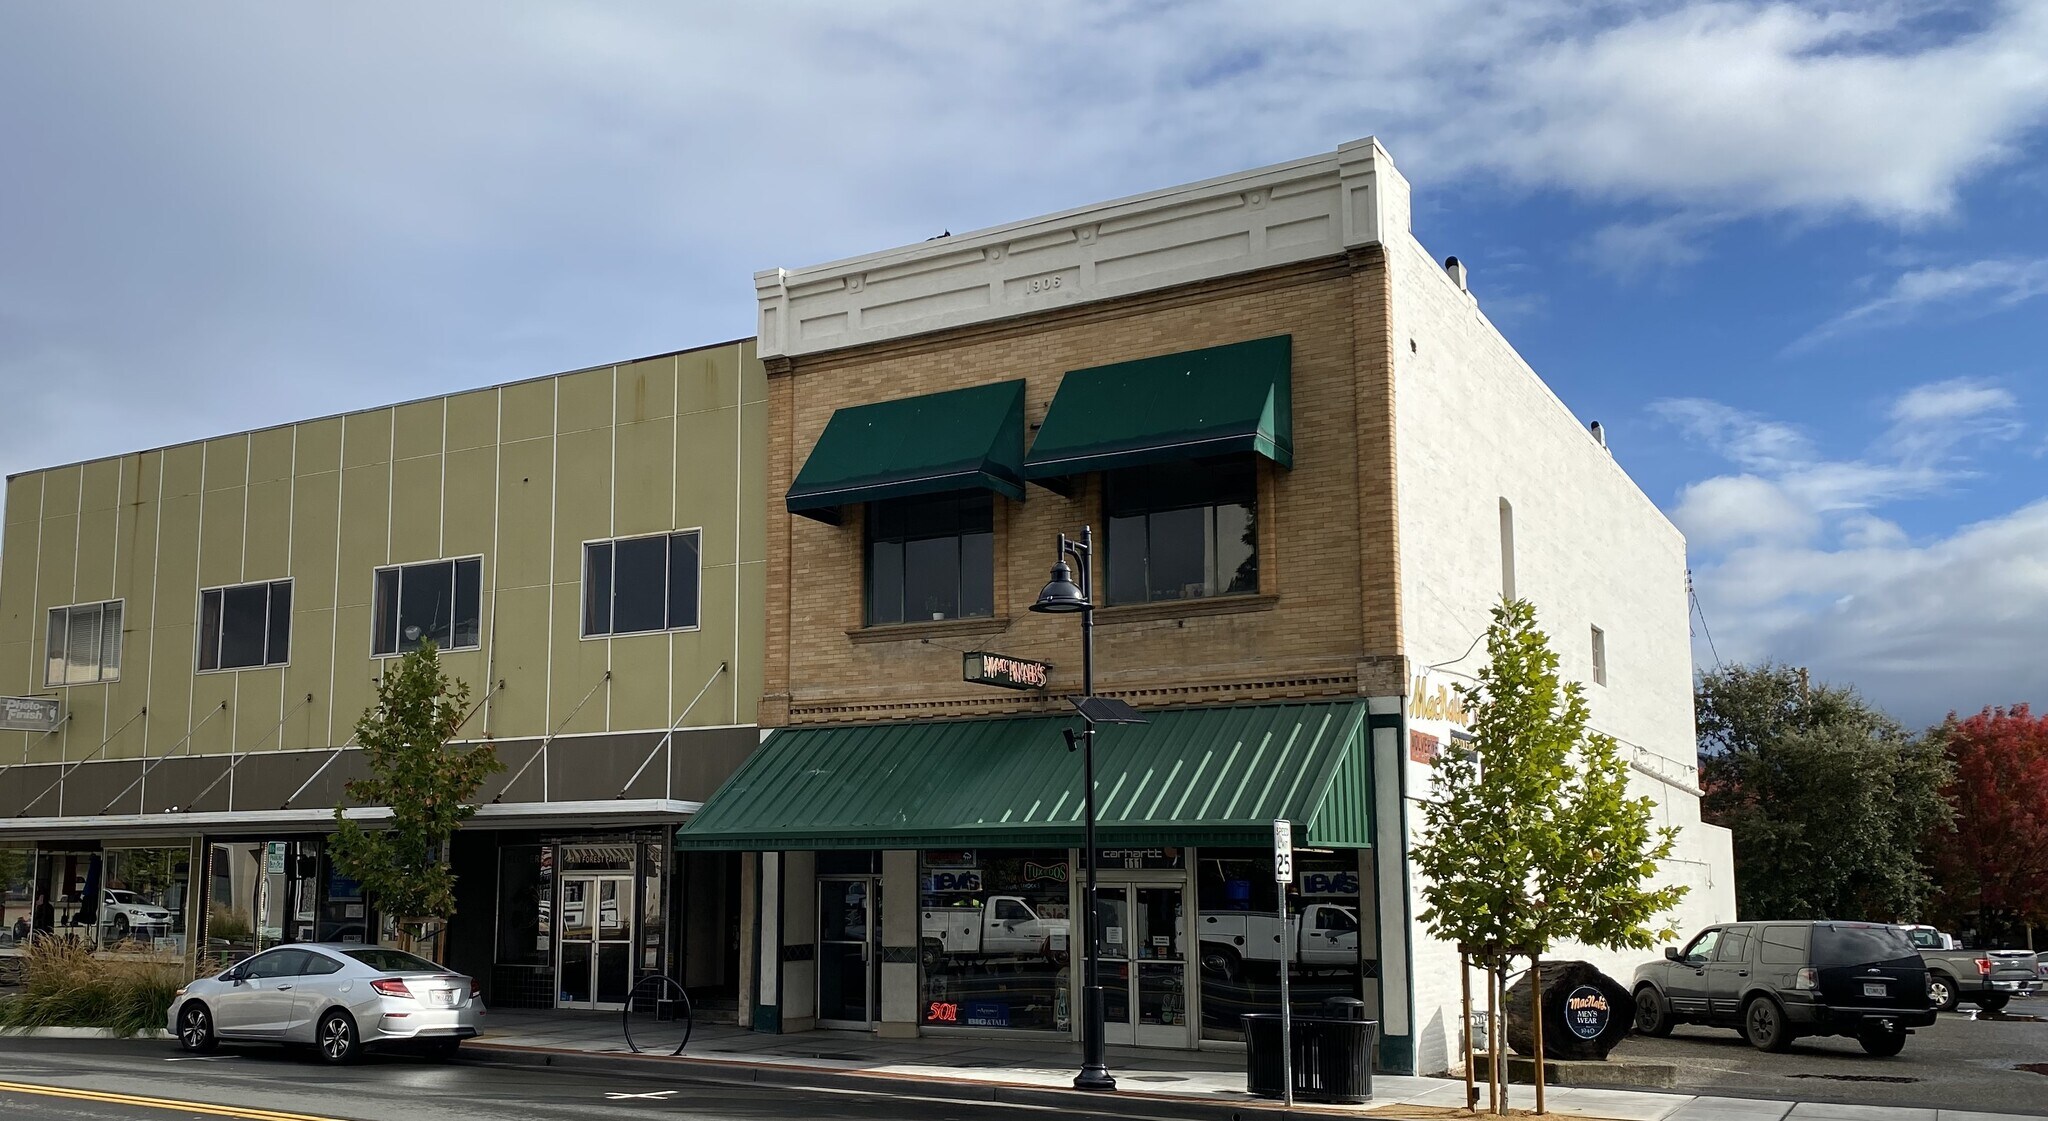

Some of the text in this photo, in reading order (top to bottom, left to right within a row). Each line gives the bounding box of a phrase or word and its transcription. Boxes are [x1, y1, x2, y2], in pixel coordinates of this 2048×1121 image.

[1026, 275, 1062, 295] 1906
[7, 709, 43, 721] Finish
[582, 855, 604, 864] FOREST
[1102, 848, 1162, 858] carhartt
[1277, 854, 1291, 875] 25
[928, 1002, 957, 1020] 501
